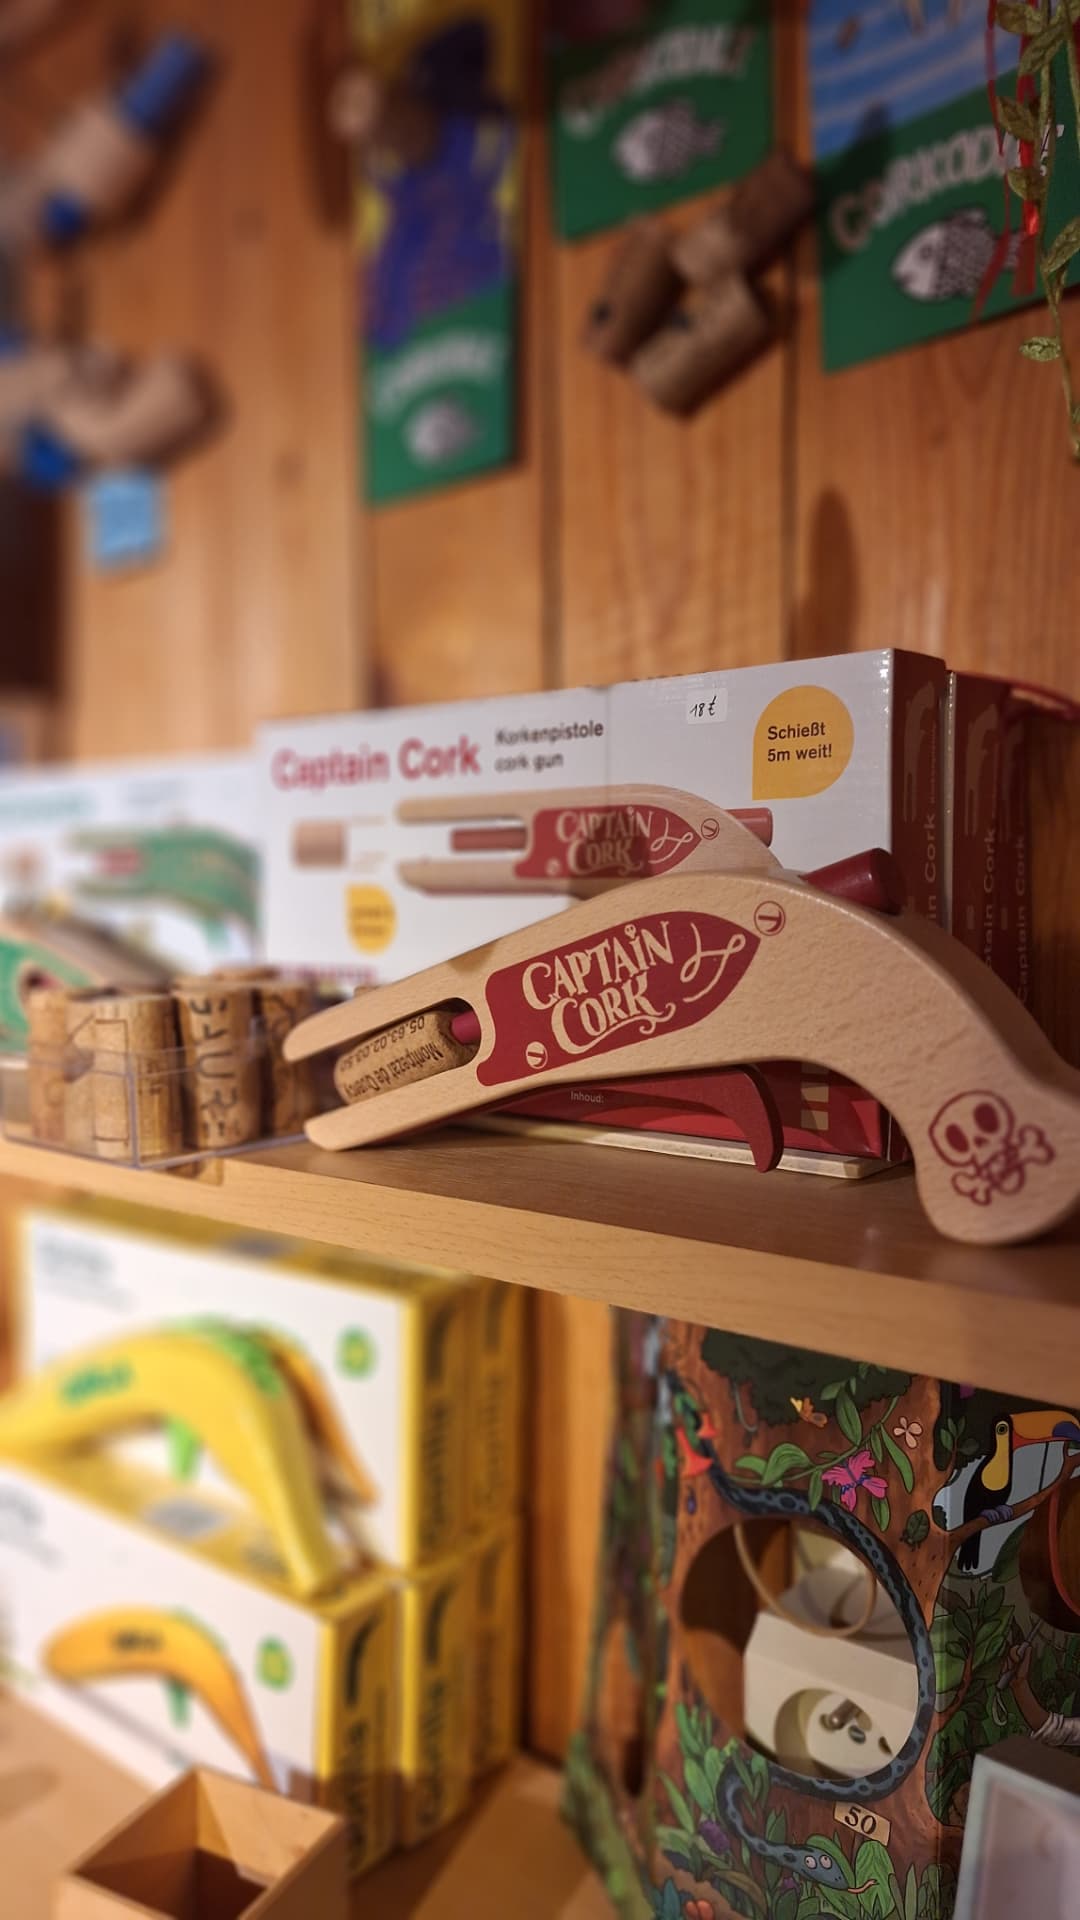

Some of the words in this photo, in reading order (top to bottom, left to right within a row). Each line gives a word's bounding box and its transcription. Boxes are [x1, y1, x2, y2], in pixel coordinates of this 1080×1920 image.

[496, 720, 604, 744] Korkenpistole
[767, 721, 826, 740] Schießt
[271, 745, 390, 790] Captain
[398, 735, 481, 781] Cork
[495, 754, 528, 772] cork
[534, 753, 563, 773] gun
[767, 748, 790, 762] 5m
[796, 743, 832, 760] weit!
[556, 806, 653, 843] CAPTAIN
[567, 837, 645, 876] CORK
[924, 813, 936, 883] Cork
[983, 828, 995, 893] Cork
[1015, 836, 1025, 896] Cork
[522, 921, 676, 1010] CAPTAIN
[551, 971, 676, 1055] CORK
[570, 1091, 604, 1103] Inhoud:
[845, 1806, 876, 1834] 50
